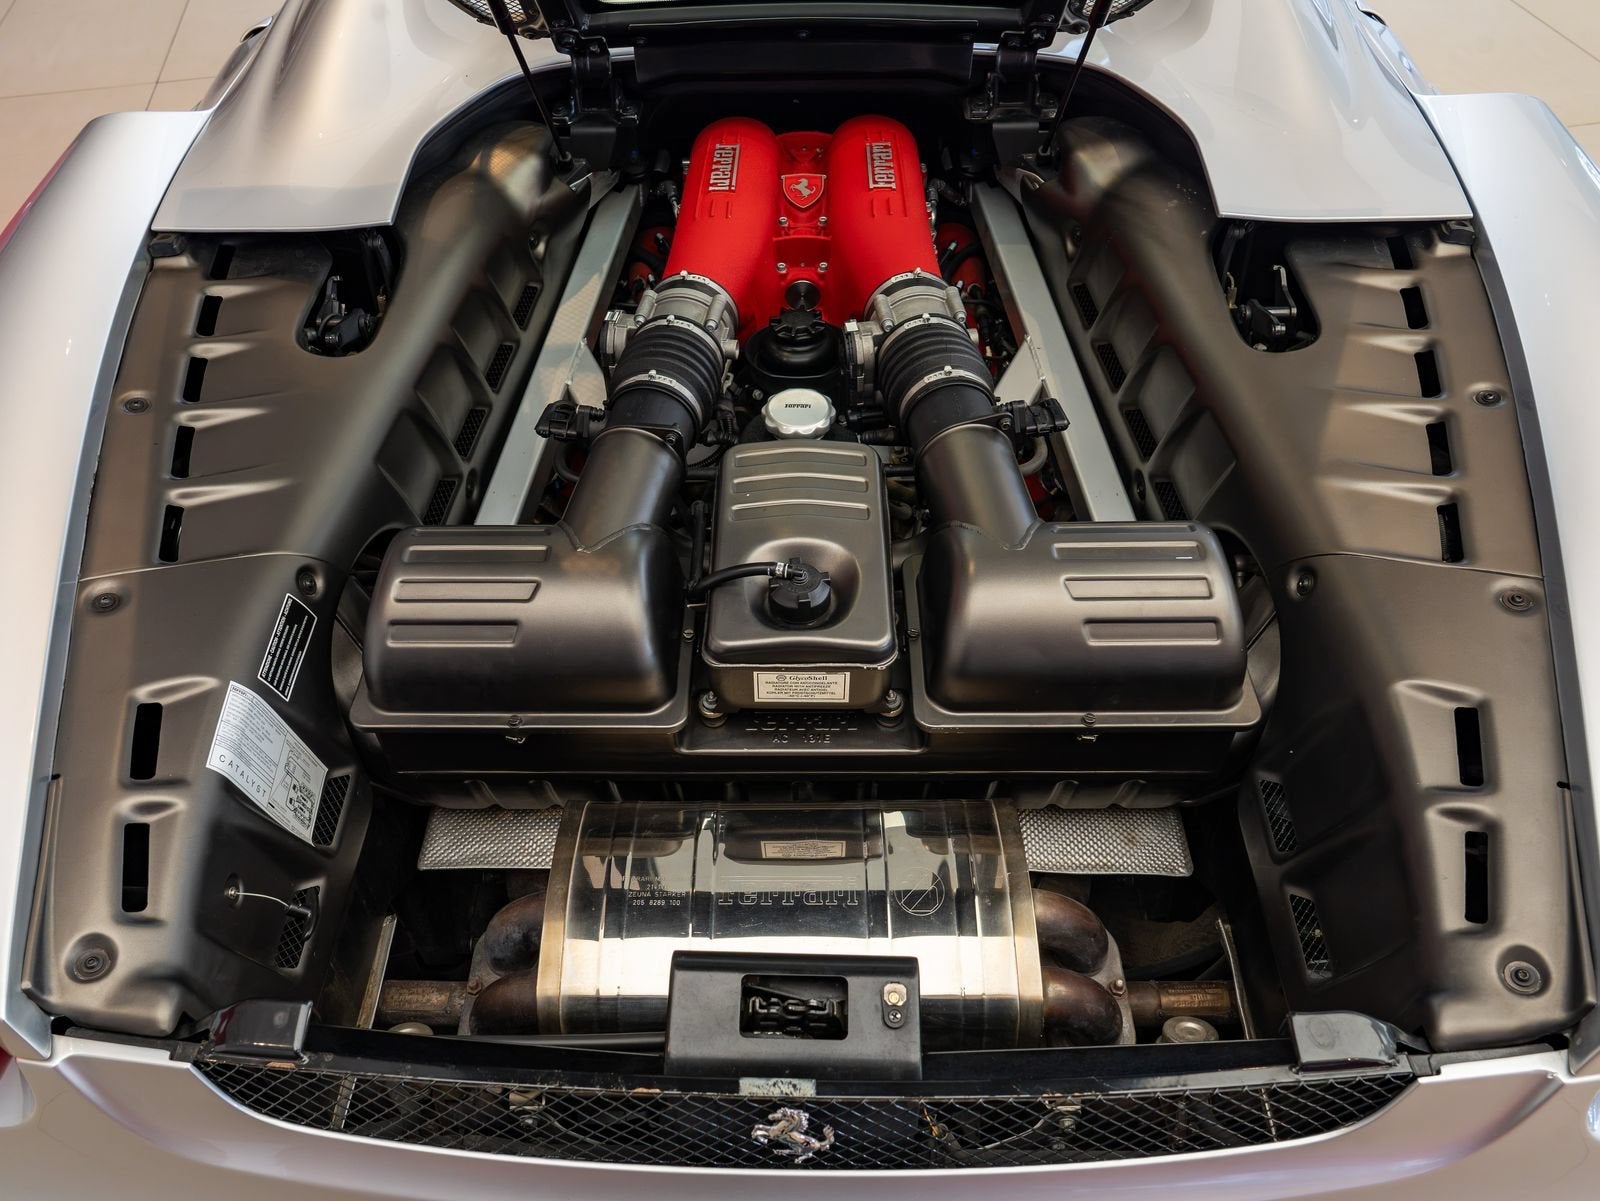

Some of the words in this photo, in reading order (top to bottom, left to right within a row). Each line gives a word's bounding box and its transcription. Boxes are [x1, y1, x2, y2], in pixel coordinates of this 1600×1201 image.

[708, 143, 740, 192] Ferrari
[865, 141, 896, 189] Ferrari
[218, 754, 266, 797] CATALYST
